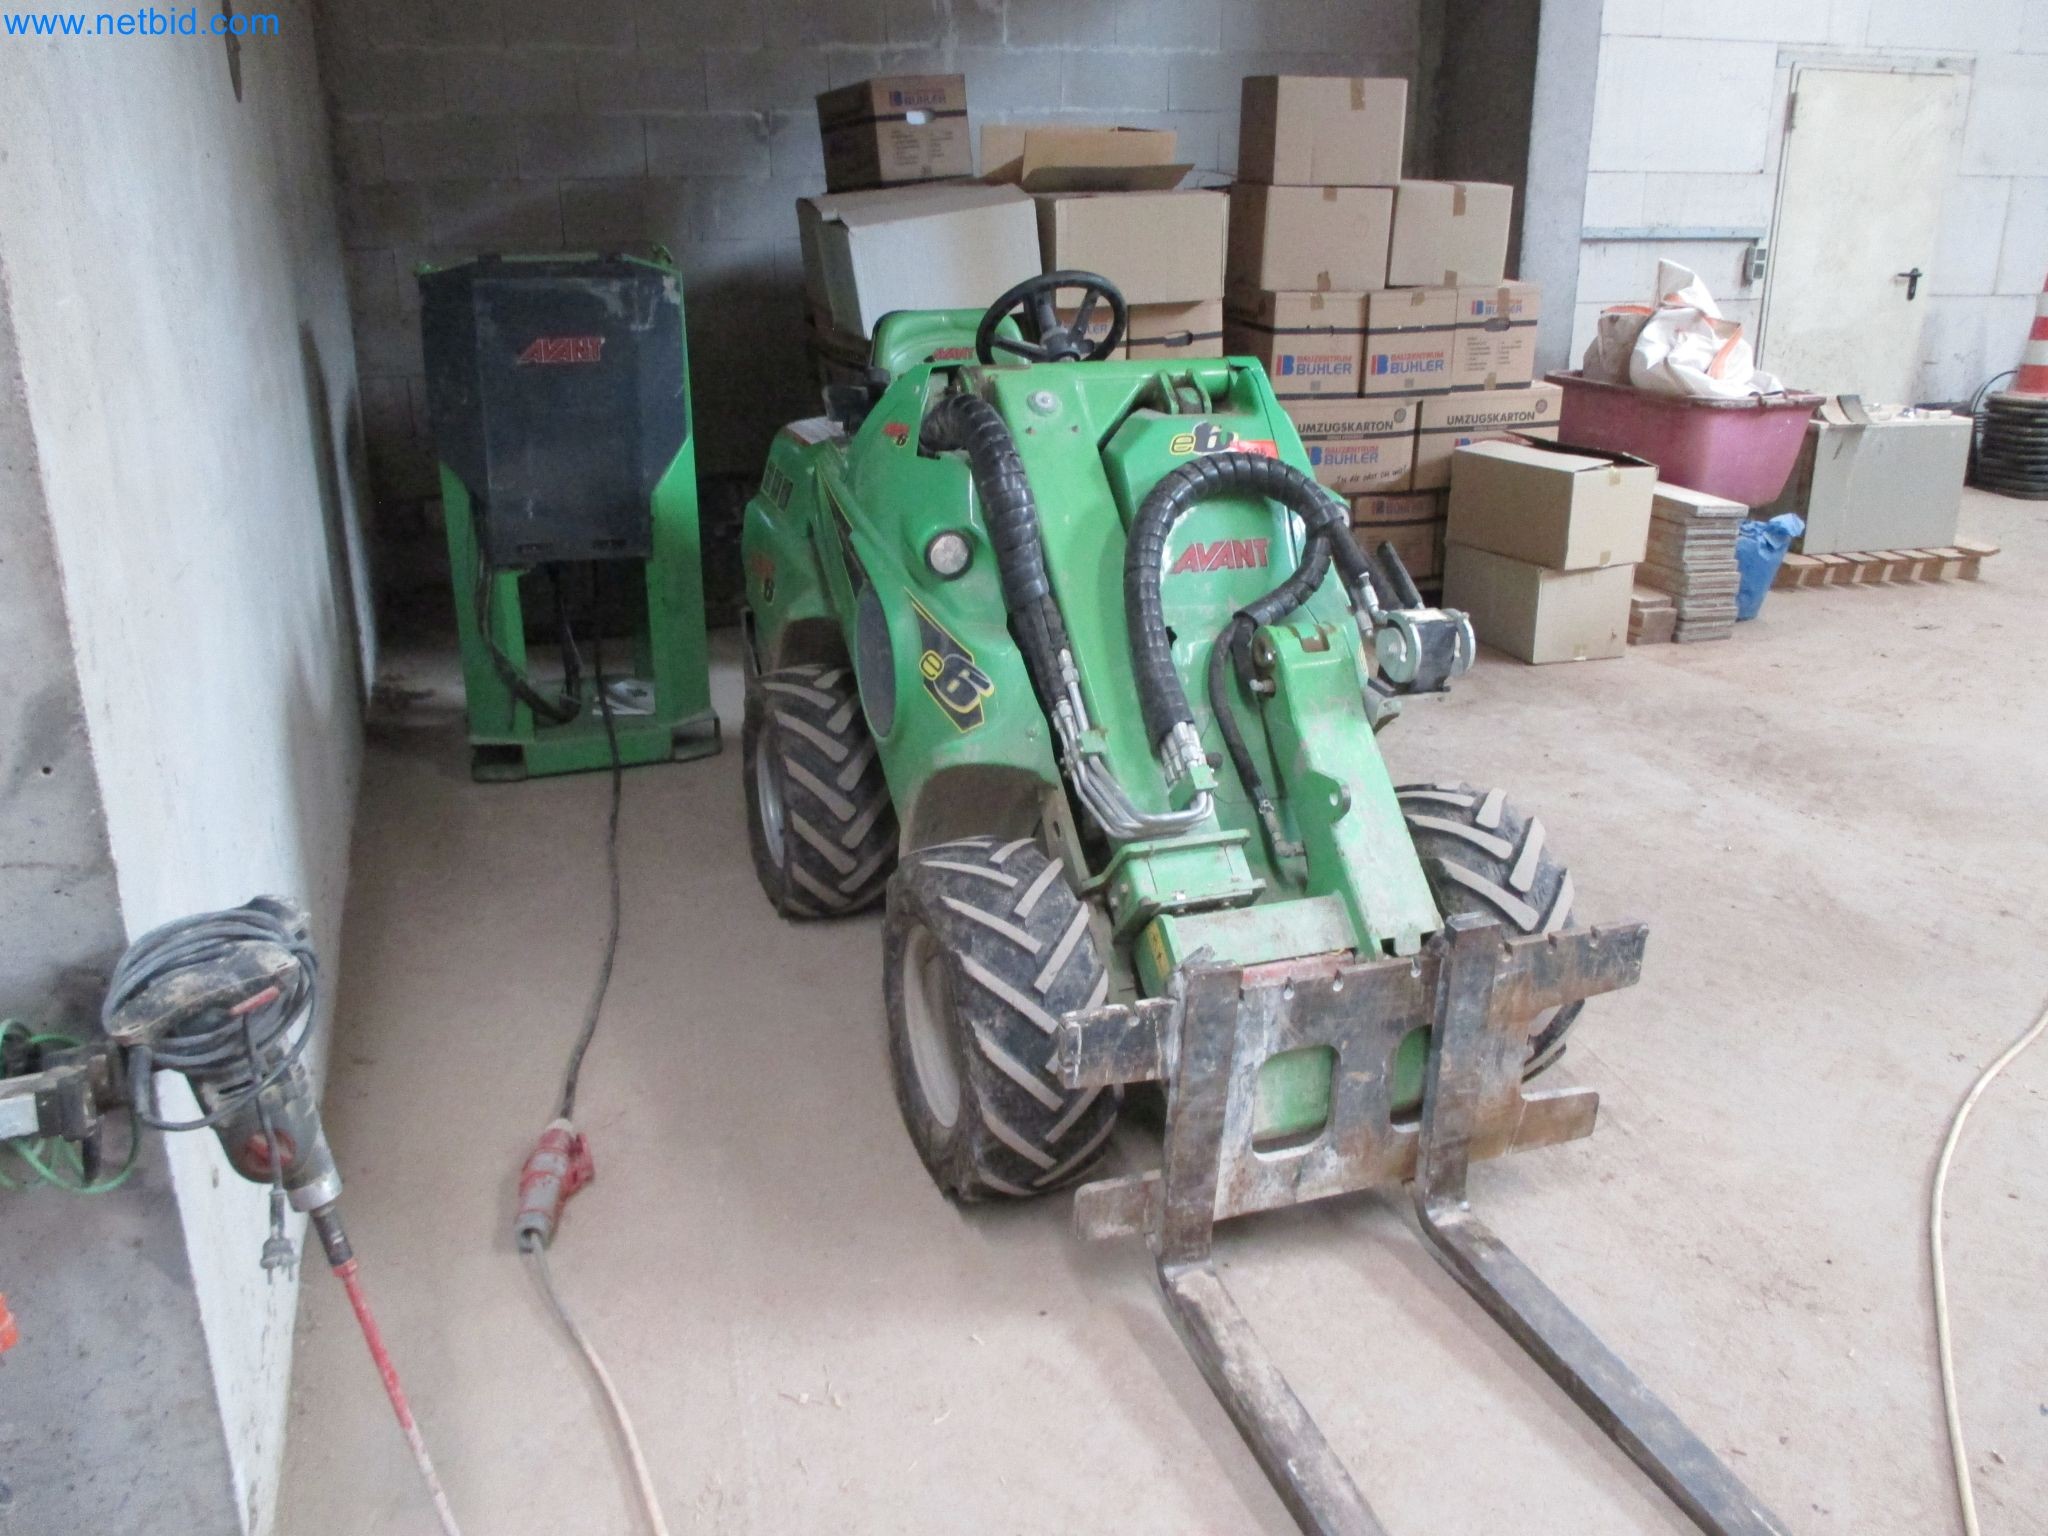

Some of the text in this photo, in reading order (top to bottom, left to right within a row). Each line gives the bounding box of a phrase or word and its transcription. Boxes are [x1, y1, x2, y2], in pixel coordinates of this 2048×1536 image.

[515, 336, 602, 364] AVANT
[1297, 420, 1394, 434] UMZUGSKARTON
[1447, 411, 1536, 426] UMZUGSKARTON
[1168, 538, 1269, 575] AVANT
